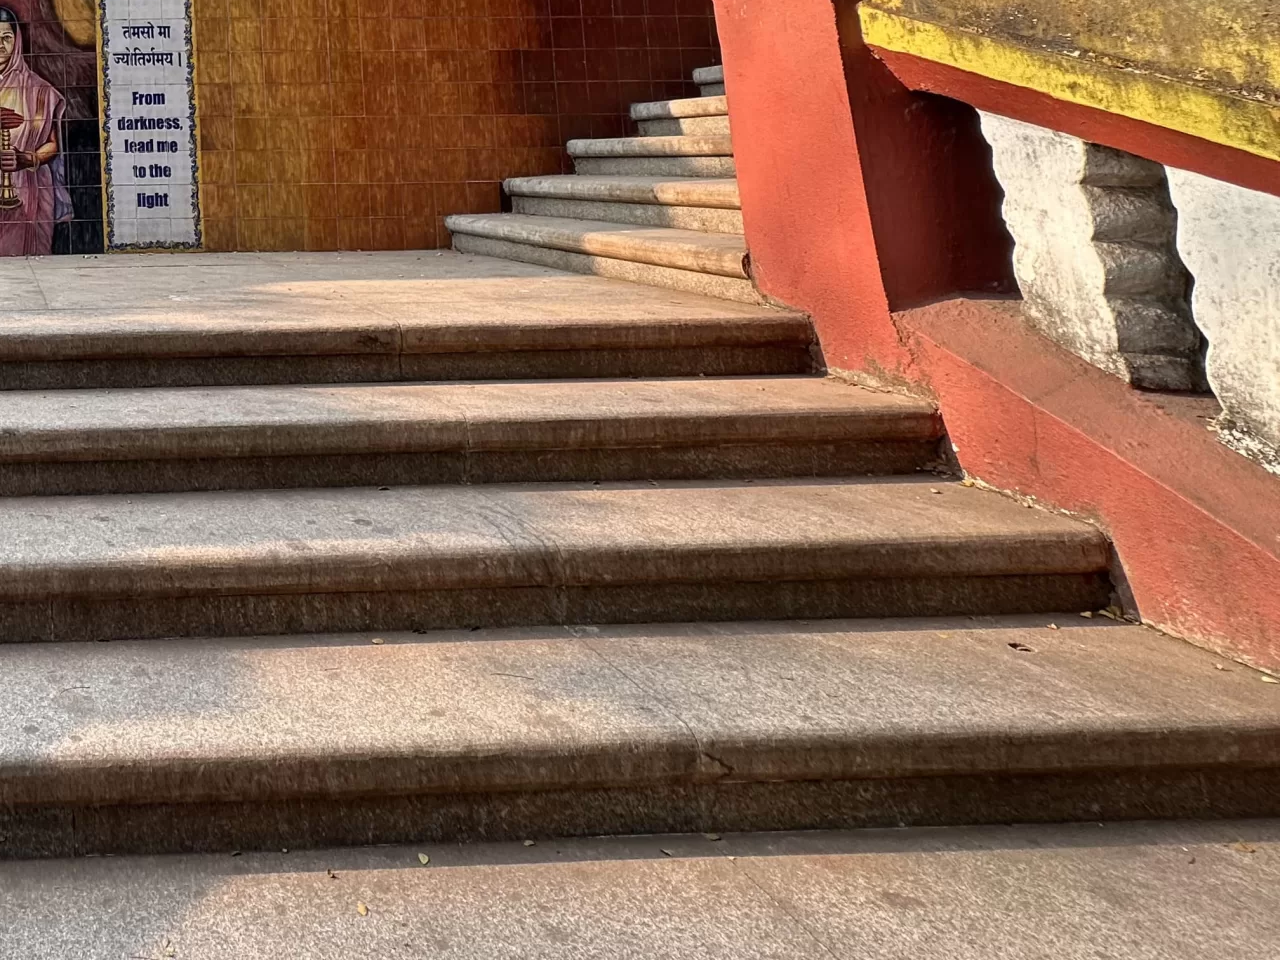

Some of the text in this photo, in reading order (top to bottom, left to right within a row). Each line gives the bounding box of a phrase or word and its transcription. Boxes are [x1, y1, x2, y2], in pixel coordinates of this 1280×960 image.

[121, 21, 171, 39] तमसो मा
[131, 91, 166, 106] From
[117, 116, 183, 131] darkness,
[124, 139, 178, 153] lead me
[132, 163, 172, 178] to the
[136, 192, 170, 209] light
